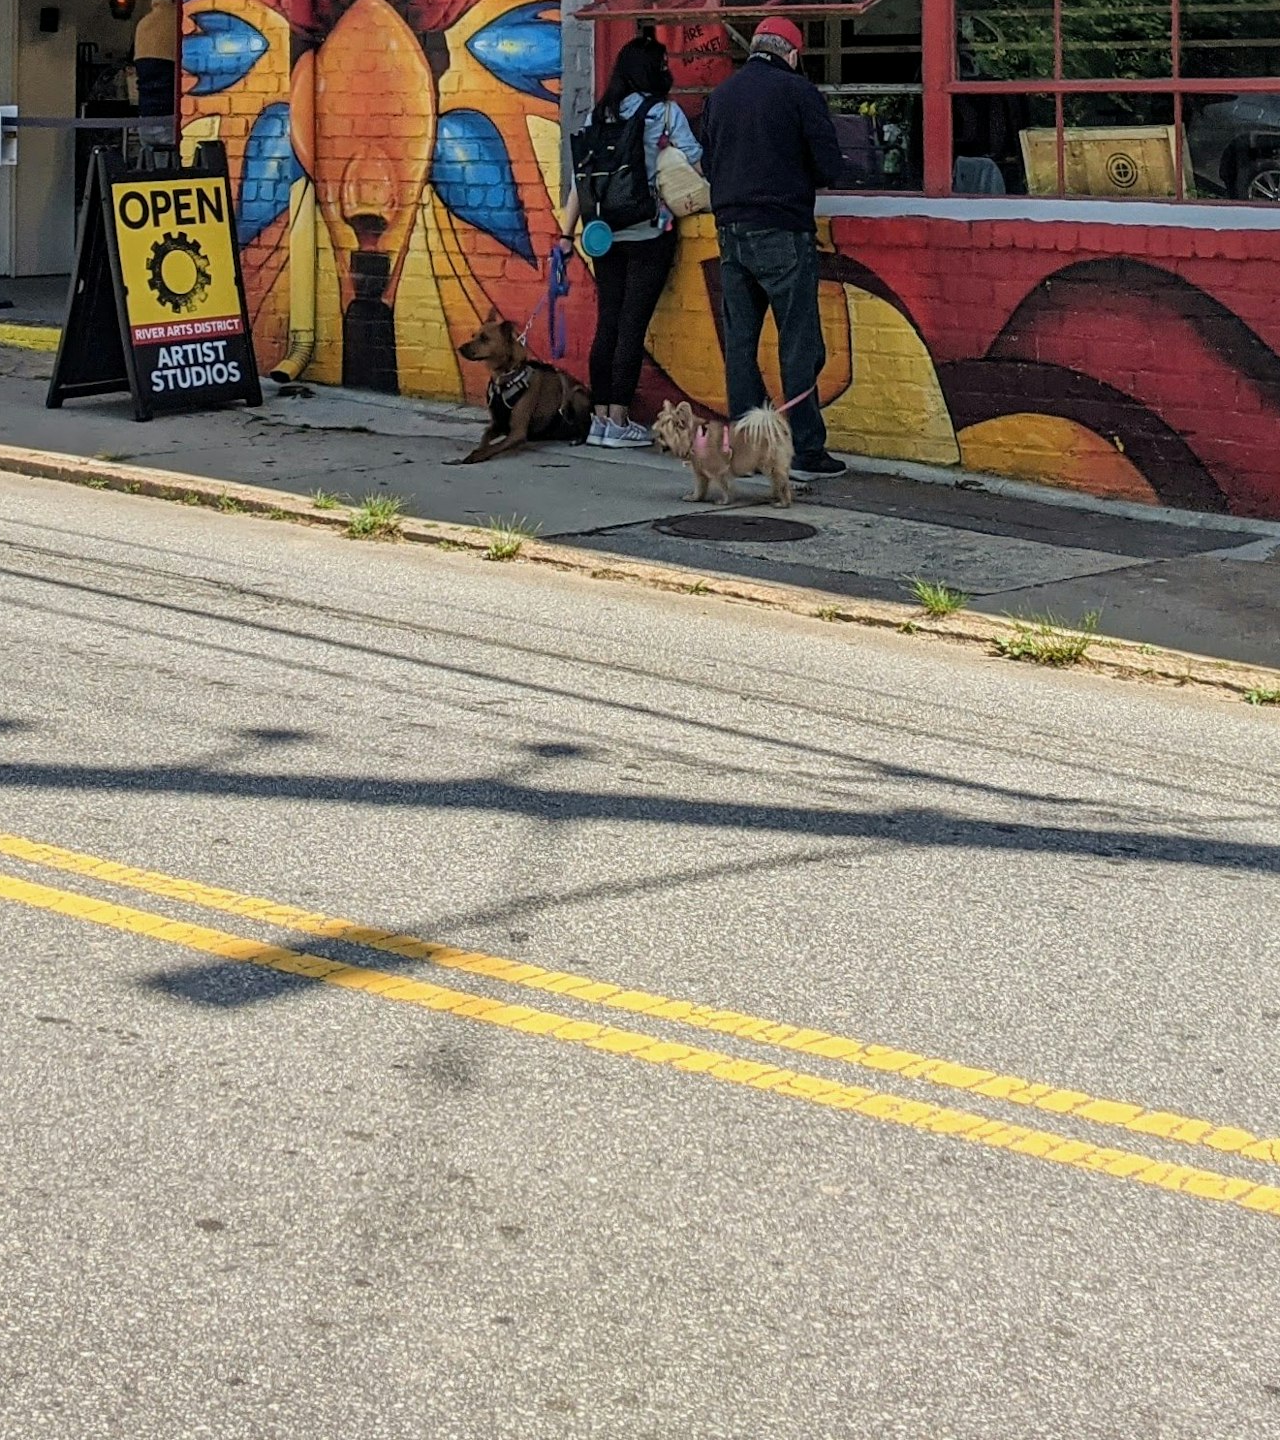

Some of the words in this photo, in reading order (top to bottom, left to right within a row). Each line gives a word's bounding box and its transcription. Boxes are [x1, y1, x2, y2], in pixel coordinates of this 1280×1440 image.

[118, 186, 224, 230] OPEN
[135, 326, 165, 340] RIVER
[166, 323, 194, 337] ARTS
[194, 318, 240, 334] DISTRICT
[157, 340, 228, 369] ARTIST
[150, 361, 242, 393] STUDIOS
